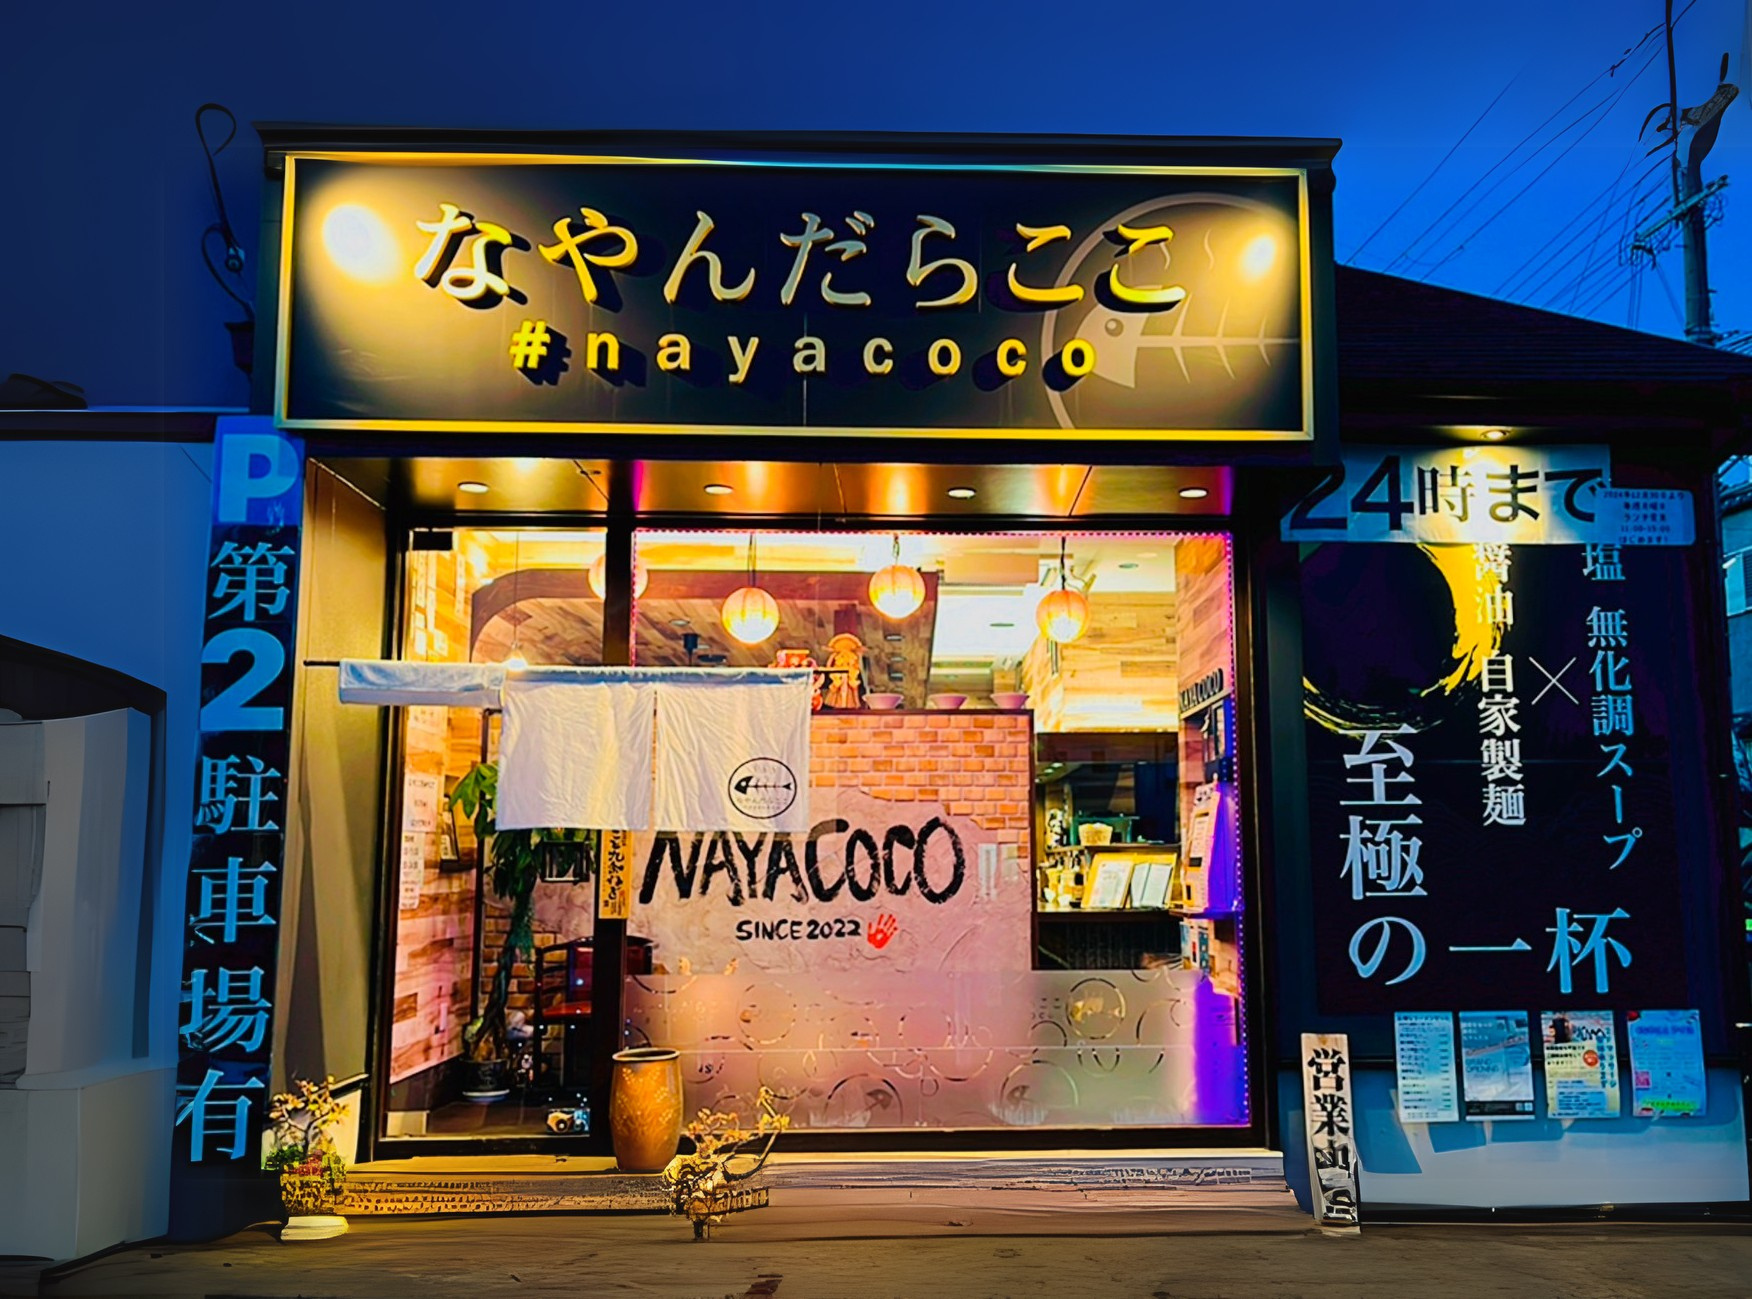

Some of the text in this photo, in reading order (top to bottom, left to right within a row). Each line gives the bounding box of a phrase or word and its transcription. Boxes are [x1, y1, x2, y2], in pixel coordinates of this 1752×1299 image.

[414, 203, 1187, 309] なやんだらここ
[218, 434, 298, 523] P
[1289, 455, 1606, 532] 24時まで
[638, 816, 966, 907] NAYACOCO
[735, 918, 862, 941] SINCE 2022
